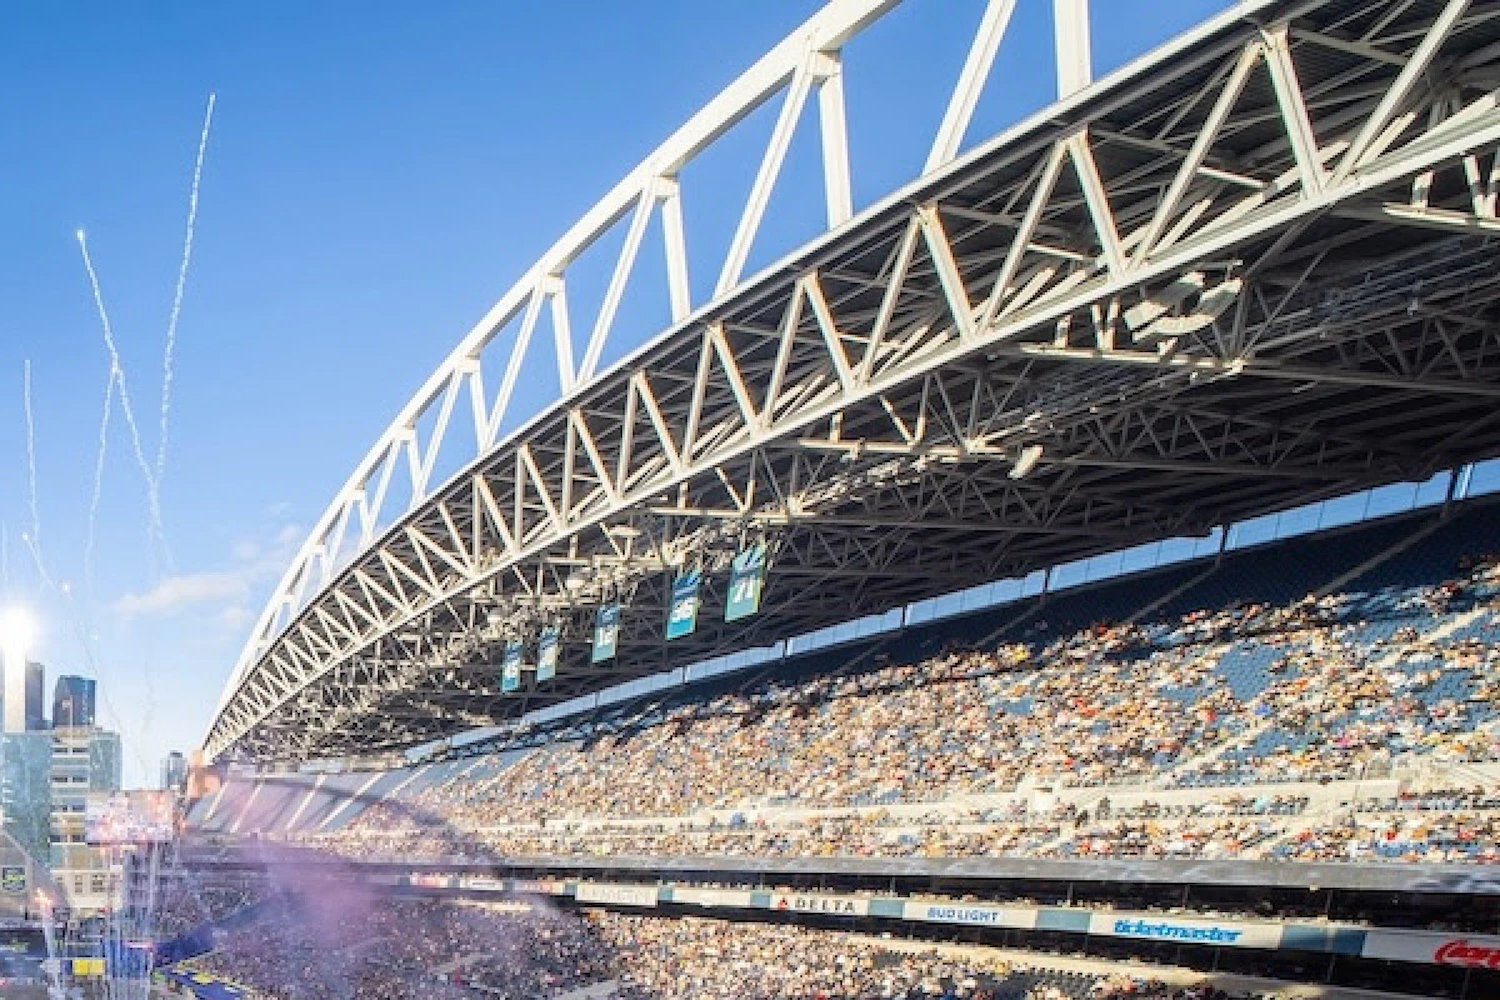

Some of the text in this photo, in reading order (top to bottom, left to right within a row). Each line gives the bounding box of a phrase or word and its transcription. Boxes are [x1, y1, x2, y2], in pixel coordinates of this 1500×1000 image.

[794, 898, 855, 912] DELTA
[926, 906, 999, 923] BUD LIGHT
[1114, 919, 1242, 942] ticketmaster
